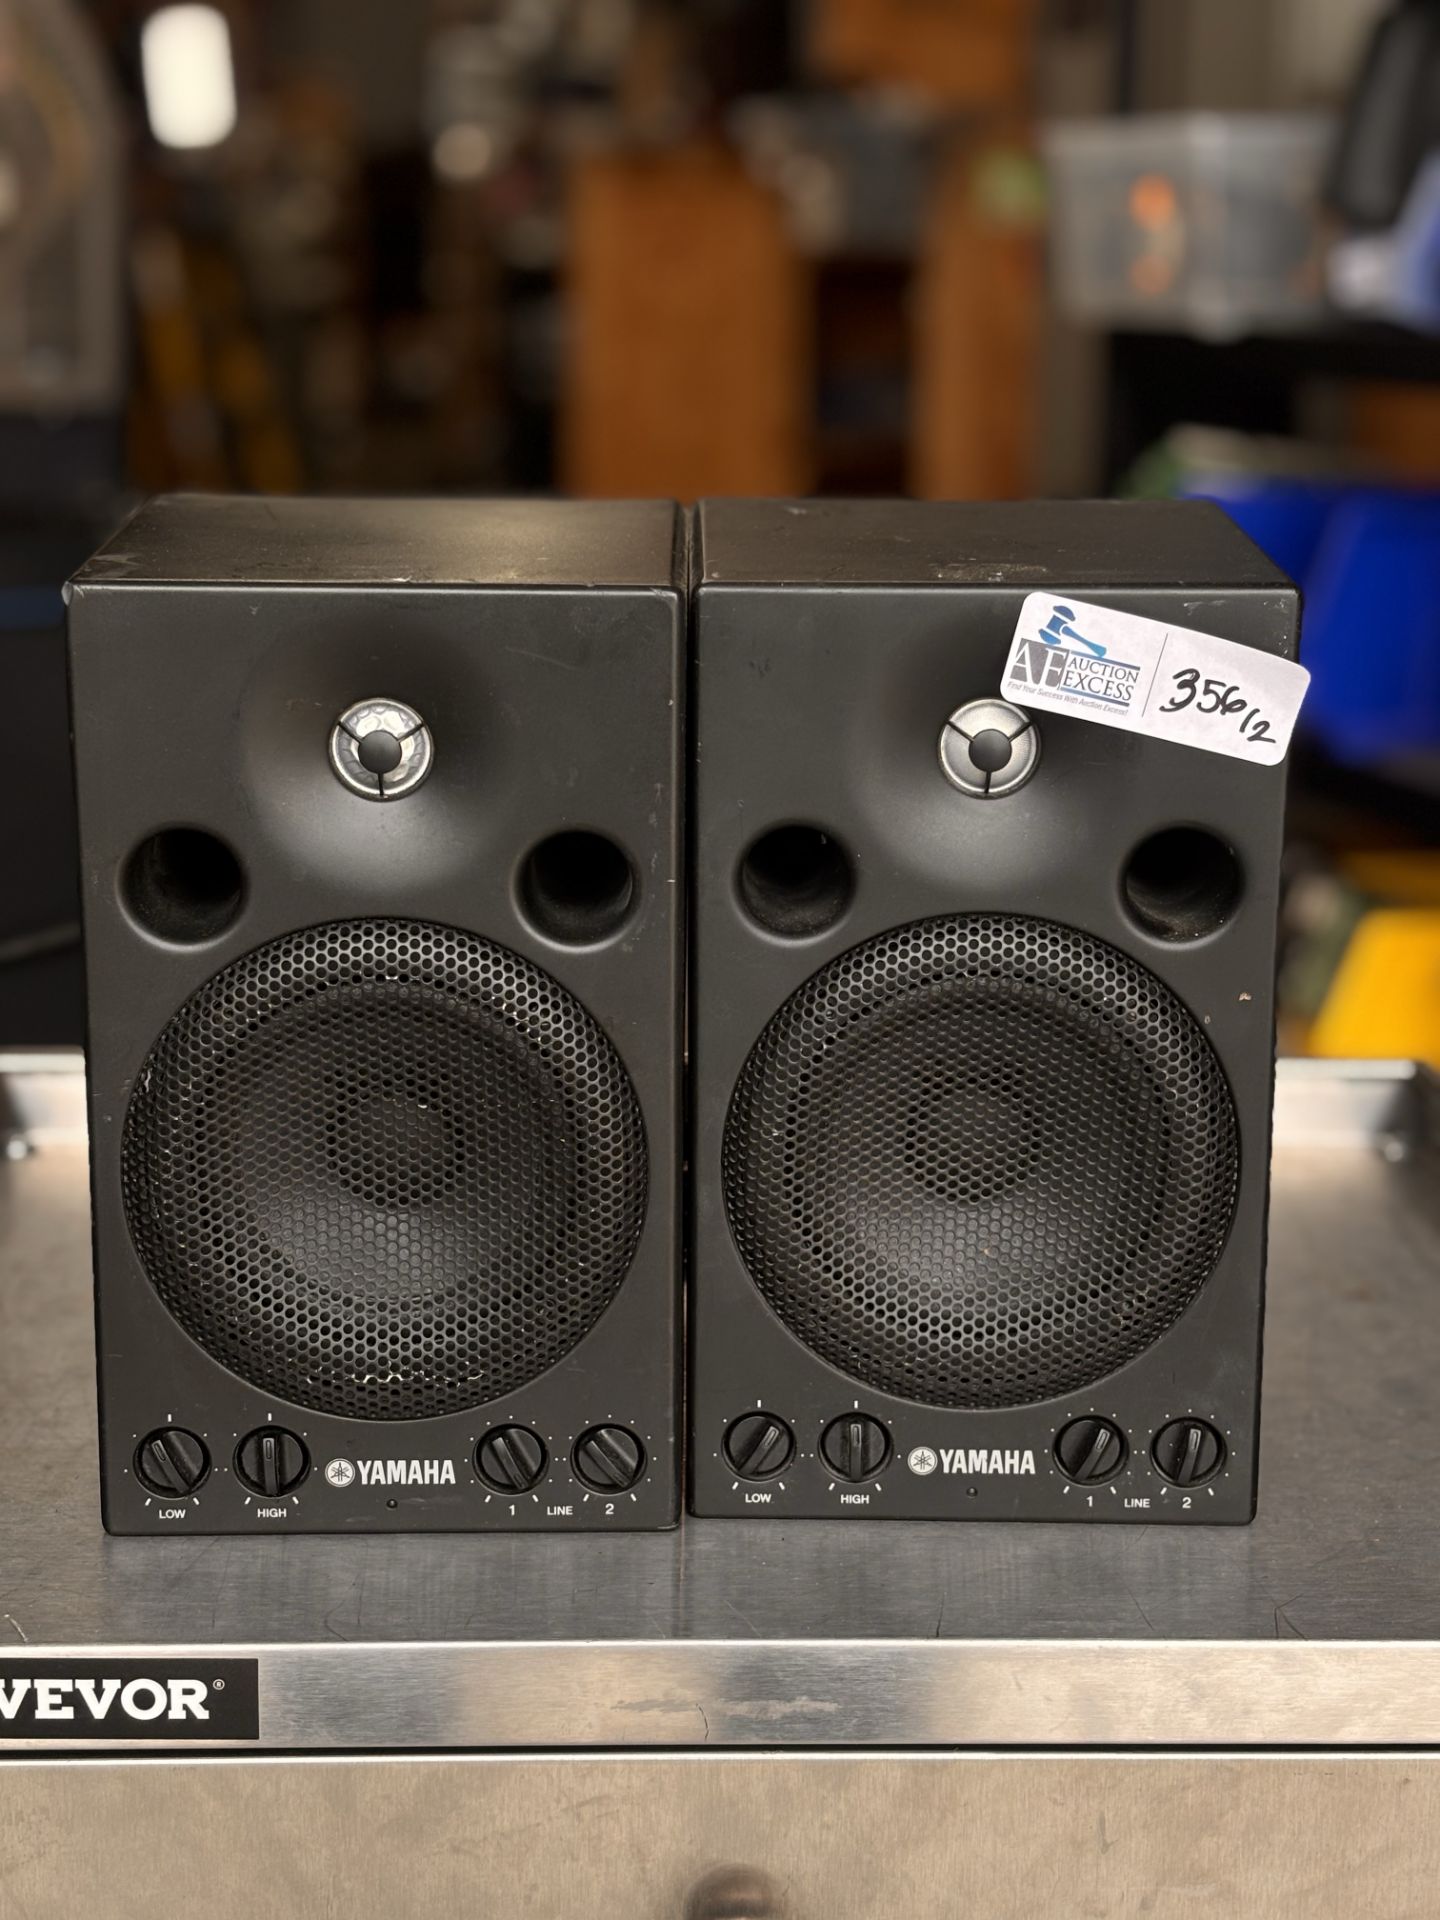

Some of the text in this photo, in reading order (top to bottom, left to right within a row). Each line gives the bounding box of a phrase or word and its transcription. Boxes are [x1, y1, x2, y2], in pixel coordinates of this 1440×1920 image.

[1067, 657, 1140, 684] AUCTION
[1062, 670, 1134, 701] EXCESS
[1007, 681, 1023, 690] Find
[1023, 685, 1038, 695] Your
[1037, 688, 1063, 700] Success
[1063, 694, 1079, 704] With
[1078, 698, 1103, 711] Auction
[939, 1448, 1037, 1476] YAMAHA
[356, 1459, 457, 1486] YAMAHA
[744, 1492, 772, 1504] LOW
[840, 1493, 871, 1505] HIGH
[1086, 1495, 1193, 1510] 1 LINE 2
[158, 1508, 187, 1520] LOW
[256, 1507, 288, 1519] HIGH
[508, 1502, 616, 1517] 1 LINE 2
